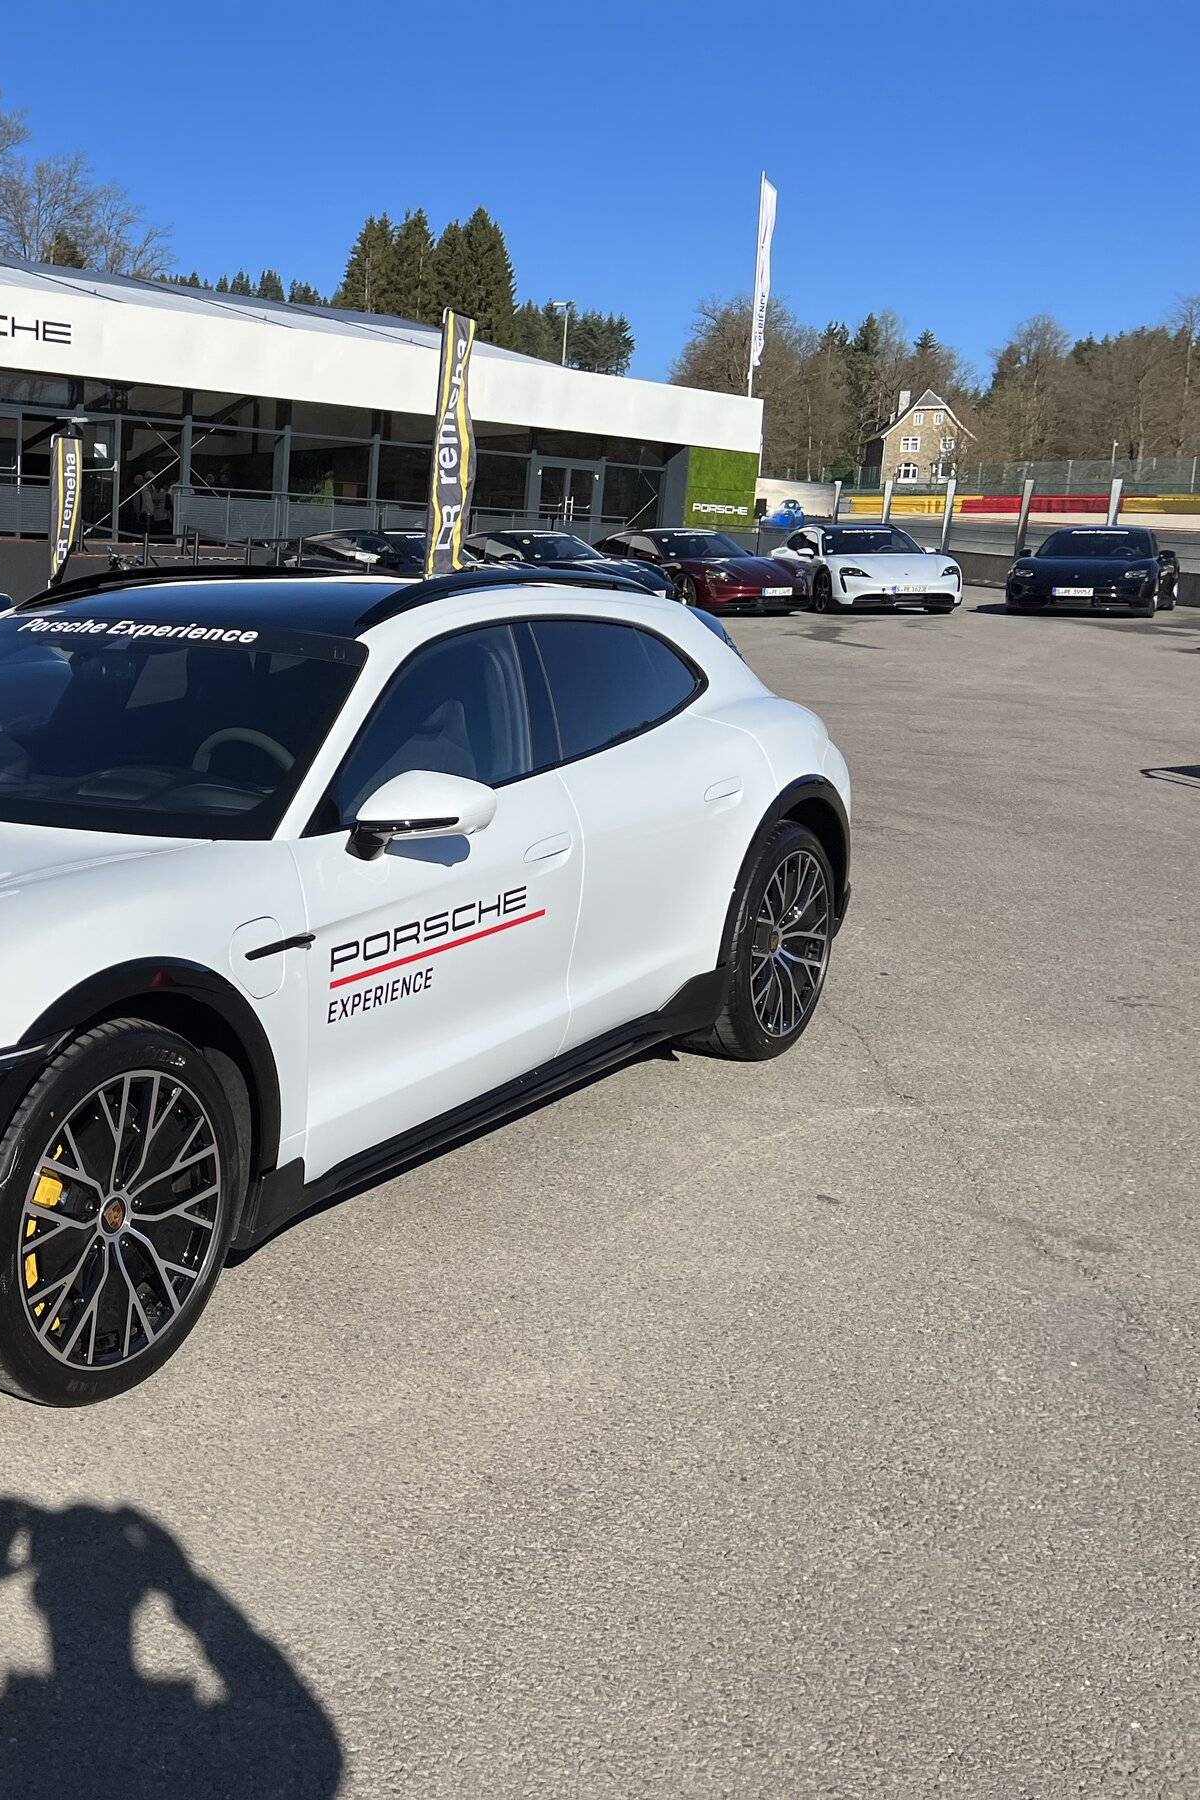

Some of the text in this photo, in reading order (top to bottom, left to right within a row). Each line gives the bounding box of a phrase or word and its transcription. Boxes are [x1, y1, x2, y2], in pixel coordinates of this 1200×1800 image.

[62, 453, 76, 529] remeha
[692, 502, 749, 516] PORSCHE
[17, 617, 259, 643] Porsche Experience
[330, 885, 527, 972] PORSCHE
[327, 967, 434, 1024] EXPERIENCE
